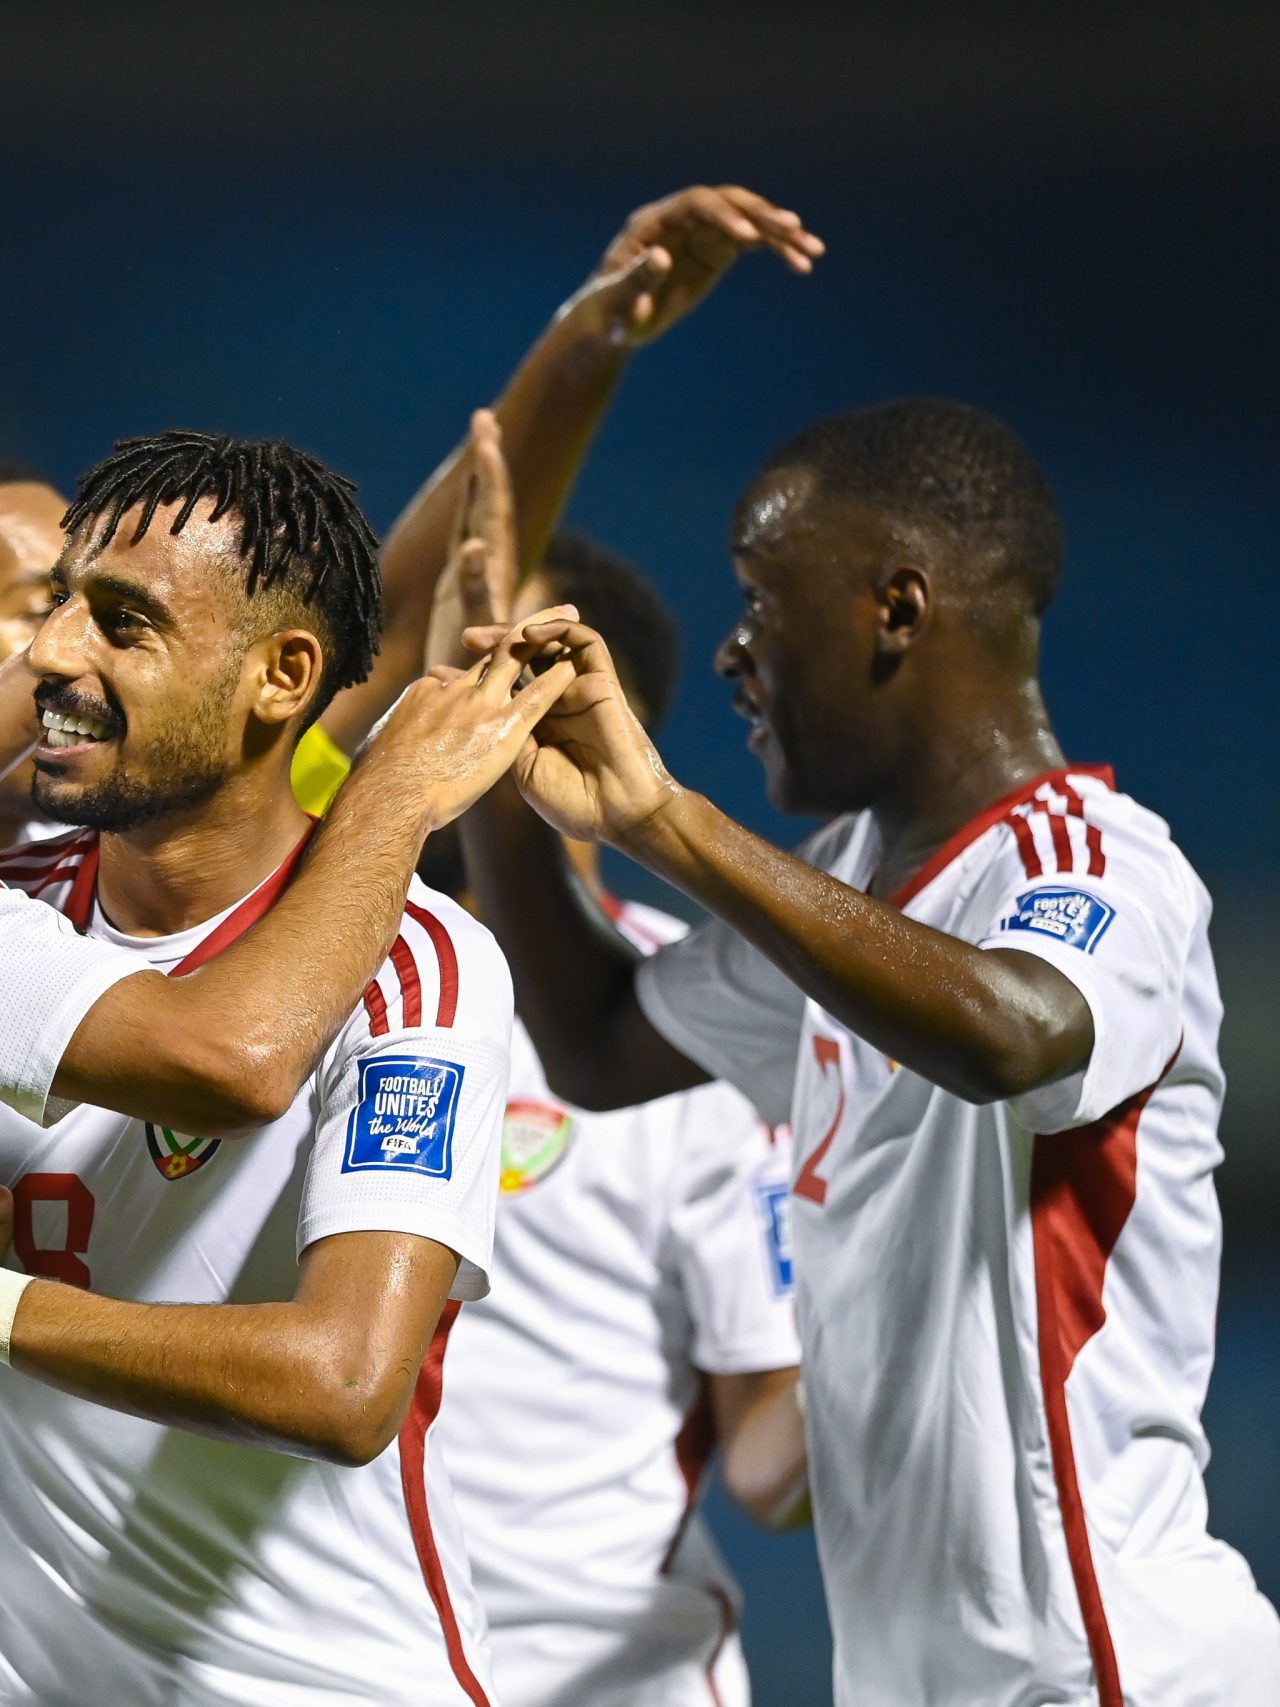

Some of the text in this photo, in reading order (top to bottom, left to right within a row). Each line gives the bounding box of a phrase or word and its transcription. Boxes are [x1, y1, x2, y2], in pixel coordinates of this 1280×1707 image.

[380, 1076, 442, 1098] FOOTBALL
[374, 1093, 439, 1118] UNITES
[368, 1116, 438, 1139] the World
[793, 1034, 845, 1207] 2
[386, 1138, 412, 1150] FIFA
[12, 1173, 95, 1289] 8
